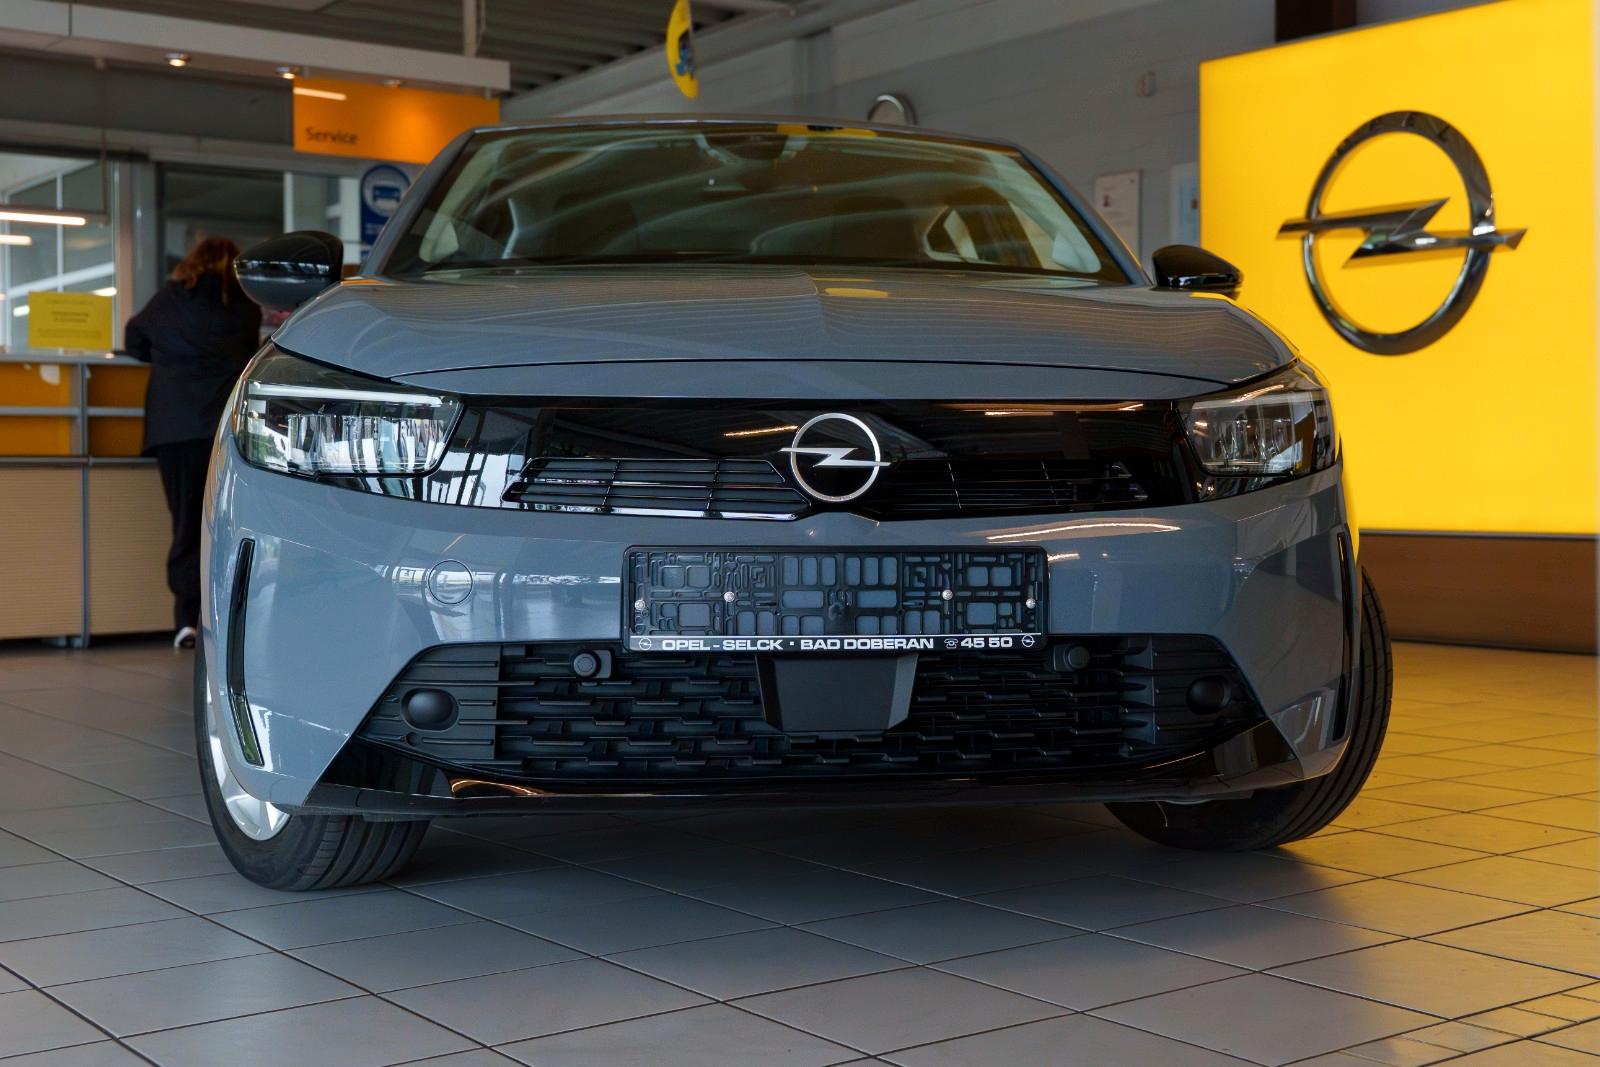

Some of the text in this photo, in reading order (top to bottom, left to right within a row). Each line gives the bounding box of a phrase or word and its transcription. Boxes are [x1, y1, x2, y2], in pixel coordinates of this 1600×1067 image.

[305, 126, 358, 145] Service
[662, 639, 711, 651] OPEL
[722, 639, 784, 650] SELCK
[800, 639, 841, 650] BAD
[843, 638, 934, 650] DOBERAN
[960, 637, 985, 648] 45
[988, 637, 1013, 648] 50
